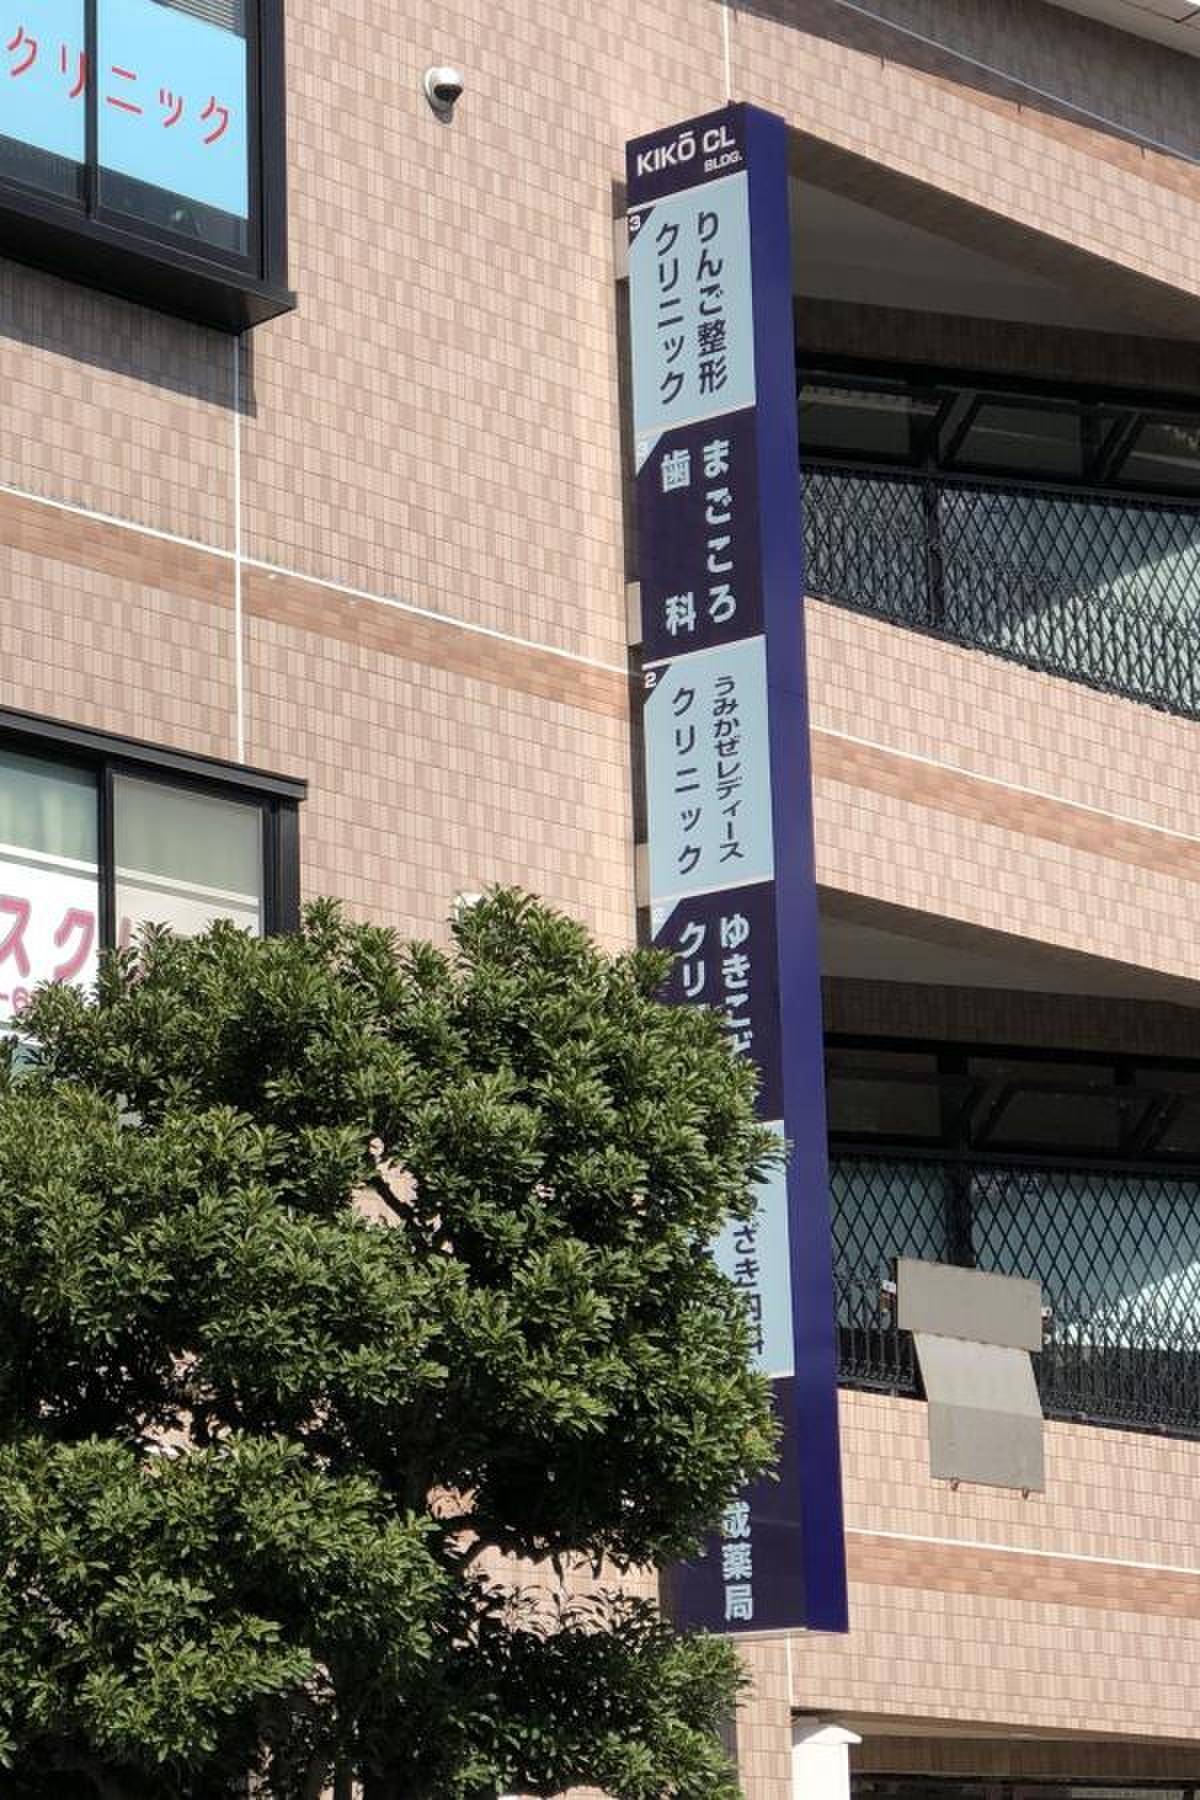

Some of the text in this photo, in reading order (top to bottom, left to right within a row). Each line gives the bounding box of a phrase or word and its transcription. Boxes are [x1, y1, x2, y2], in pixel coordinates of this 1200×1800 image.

[703, 125, 737, 154] CL
[656, 222, 685, 405] クリニック
[697, 210, 728, 395] りんご整形
[661, 448, 697, 636] 歯科
[703, 439, 737, 624] まごころ
[643, 671, 657, 689] 2
[713, 675, 744, 864] うみかぜレディース
[672, 687, 702, 875] クリニック
[678, 921, 707, 997] クリ
